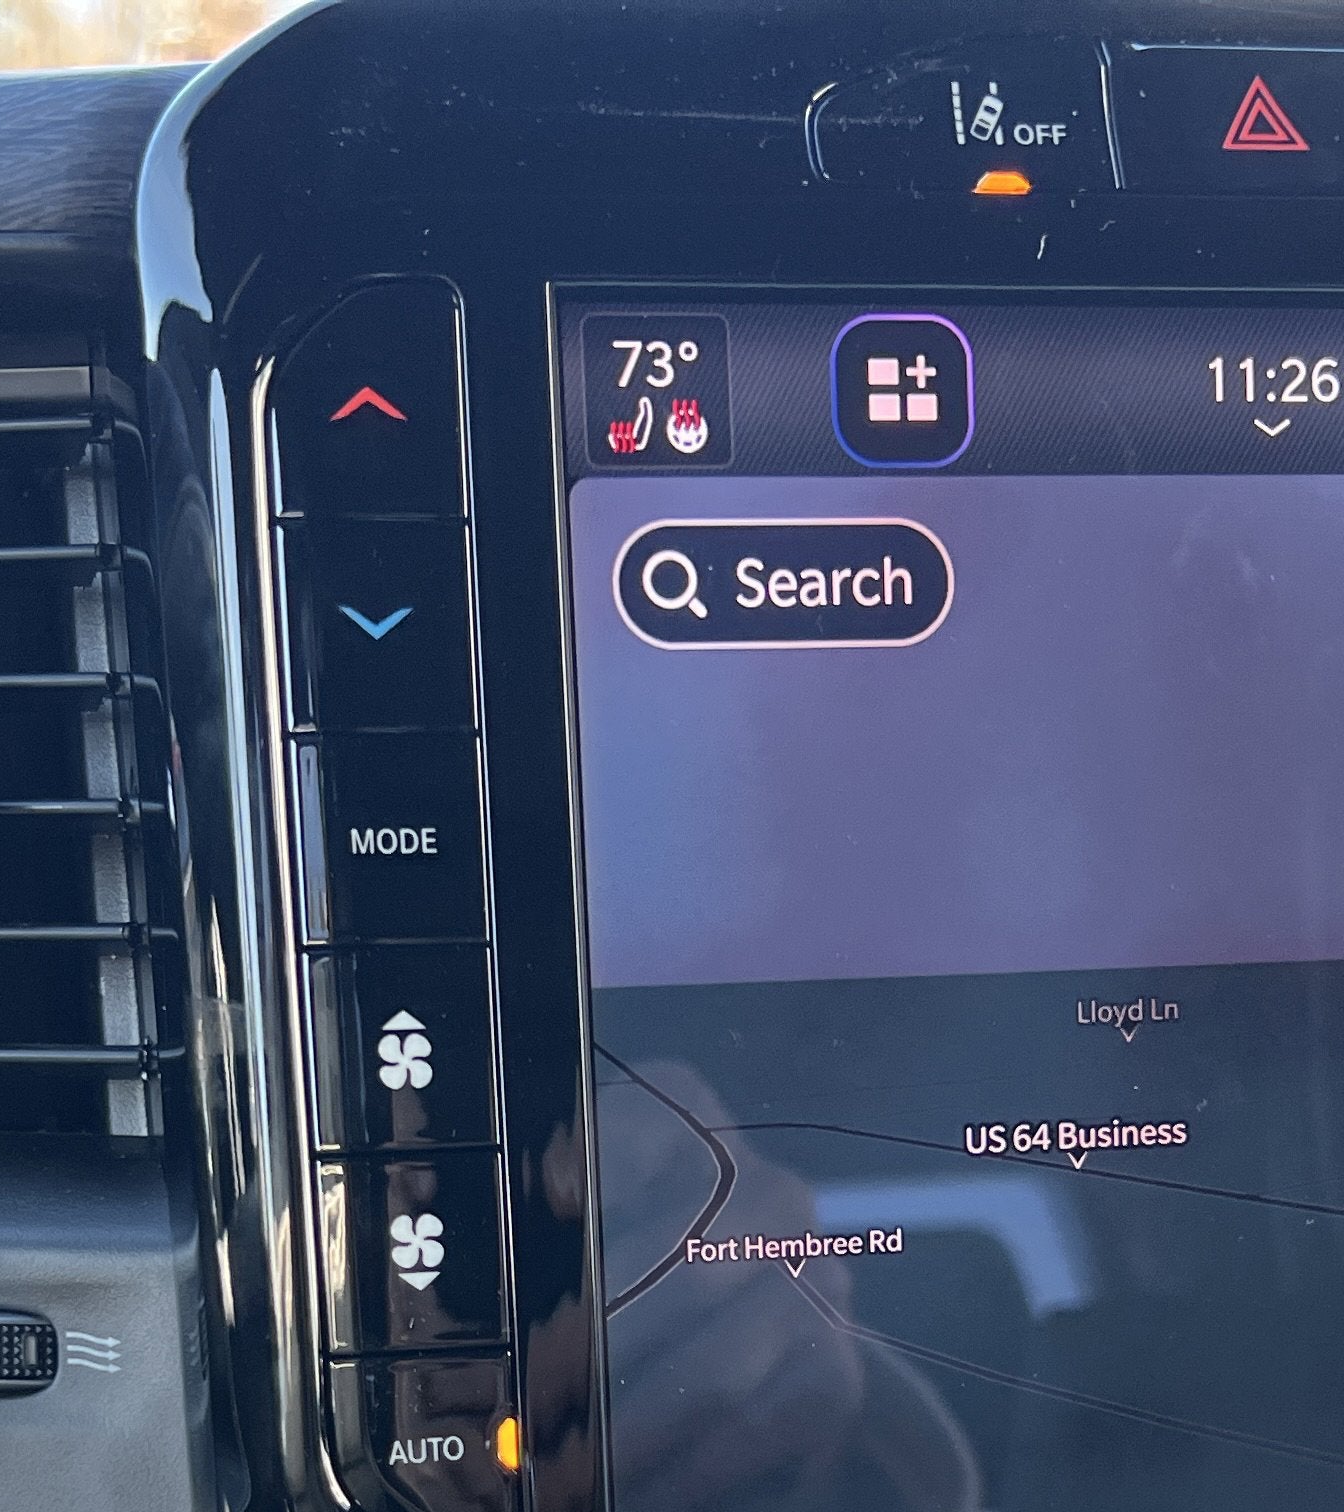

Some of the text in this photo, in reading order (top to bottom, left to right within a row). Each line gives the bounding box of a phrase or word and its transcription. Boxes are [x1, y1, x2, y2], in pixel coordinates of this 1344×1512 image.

[1013, 123, 1067, 146] OFF
[611, 340, 700, 389] 73°
[1207, 356, 1341, 405] 11:26
[735, 554, 914, 608] Search
[350, 827, 438, 857] MODE
[1077, 998, 1179, 1029] Lloyd Ln
[964, 1119, 1187, 1155] US 64 Business
[686, 1227, 904, 1264] Fort Hembree Rd
[389, 1434, 465, 1466] AUTO
